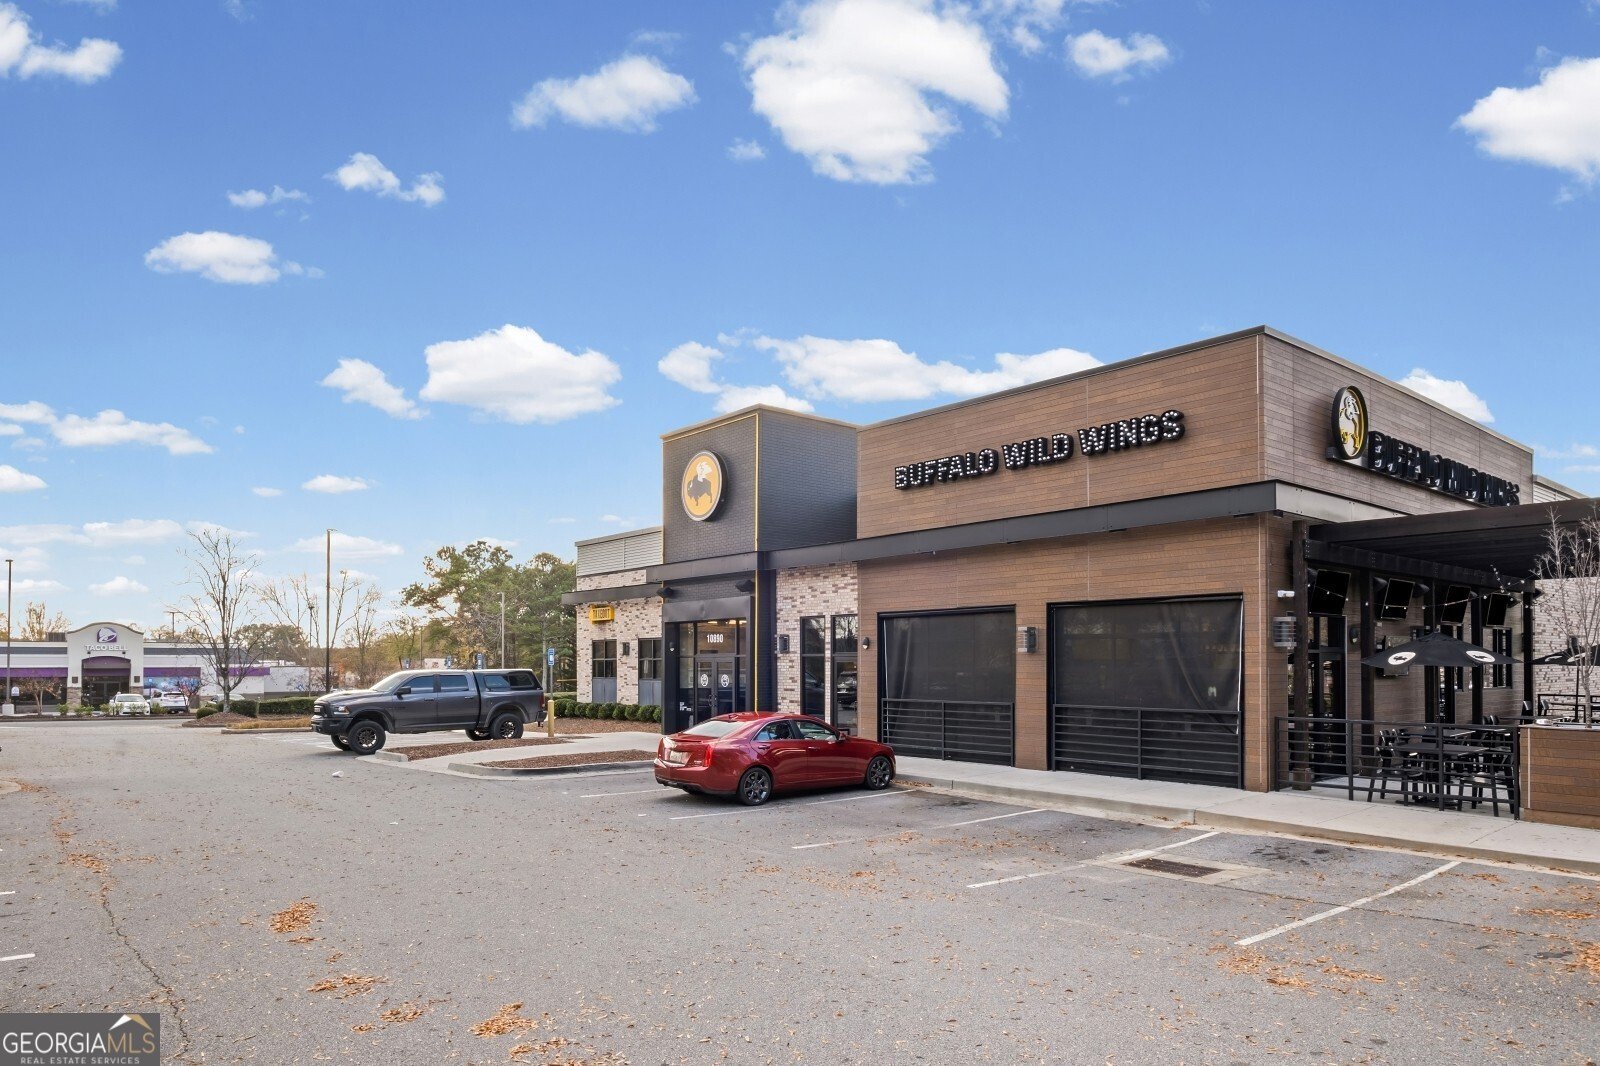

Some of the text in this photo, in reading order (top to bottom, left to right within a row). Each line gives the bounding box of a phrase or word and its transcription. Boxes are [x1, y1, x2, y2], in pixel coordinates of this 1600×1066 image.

[895, 409, 1185, 490] BUFFALO WILD WINGS
